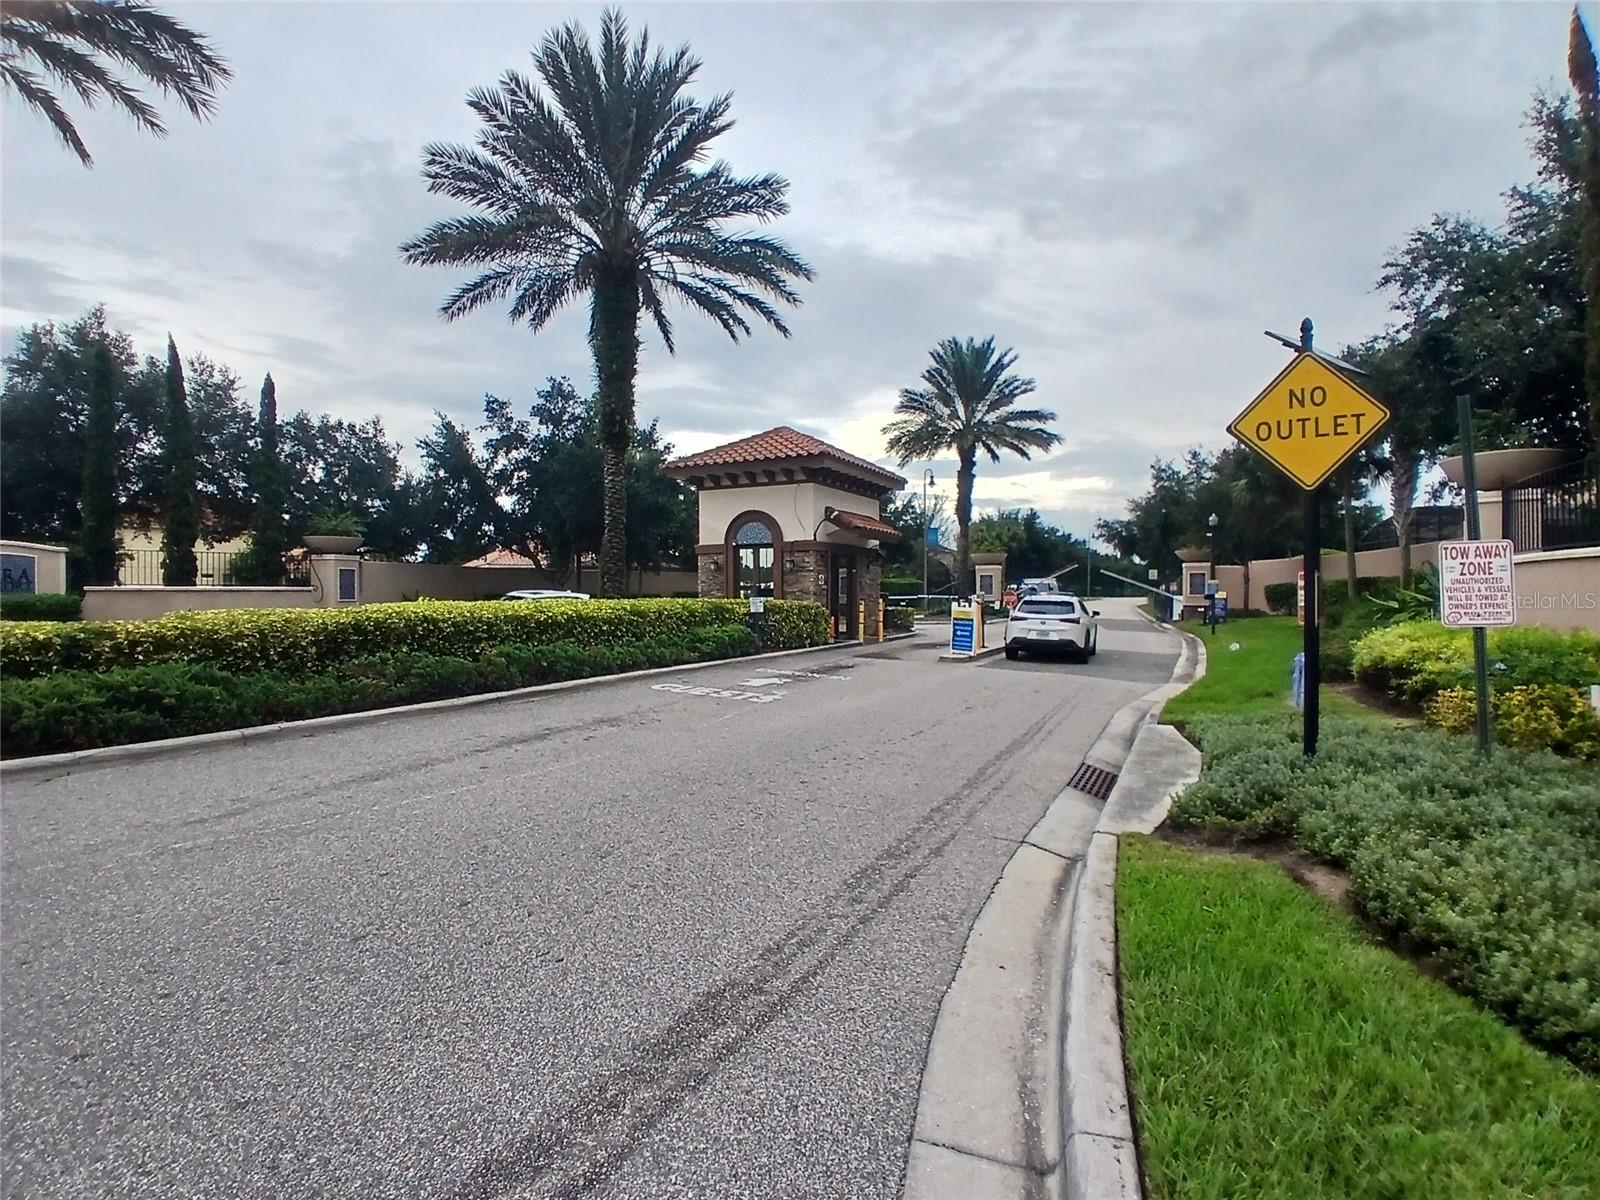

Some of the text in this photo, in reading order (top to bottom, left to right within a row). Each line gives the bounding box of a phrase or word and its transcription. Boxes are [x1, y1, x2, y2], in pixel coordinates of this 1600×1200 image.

[1289, 386, 1327, 409] NO
[1255, 413, 1366, 442] OUTLET
[1443, 545, 1508, 560] TOW AWAY
[1459, 561, 1493, 576] ZONE
[1451, 577, 1503, 585] UNAUTHORIZED
[1445, 586, 1475, 594] VEHICLES
[1484, 585, 1510, 593] VESSELS
[1448, 594, 1463, 602] WILL
[1465, 594, 1473, 602] BE
[1475, 594, 1499, 602] TOWED
[1480, 601, 1508, 610] EXPENSE
